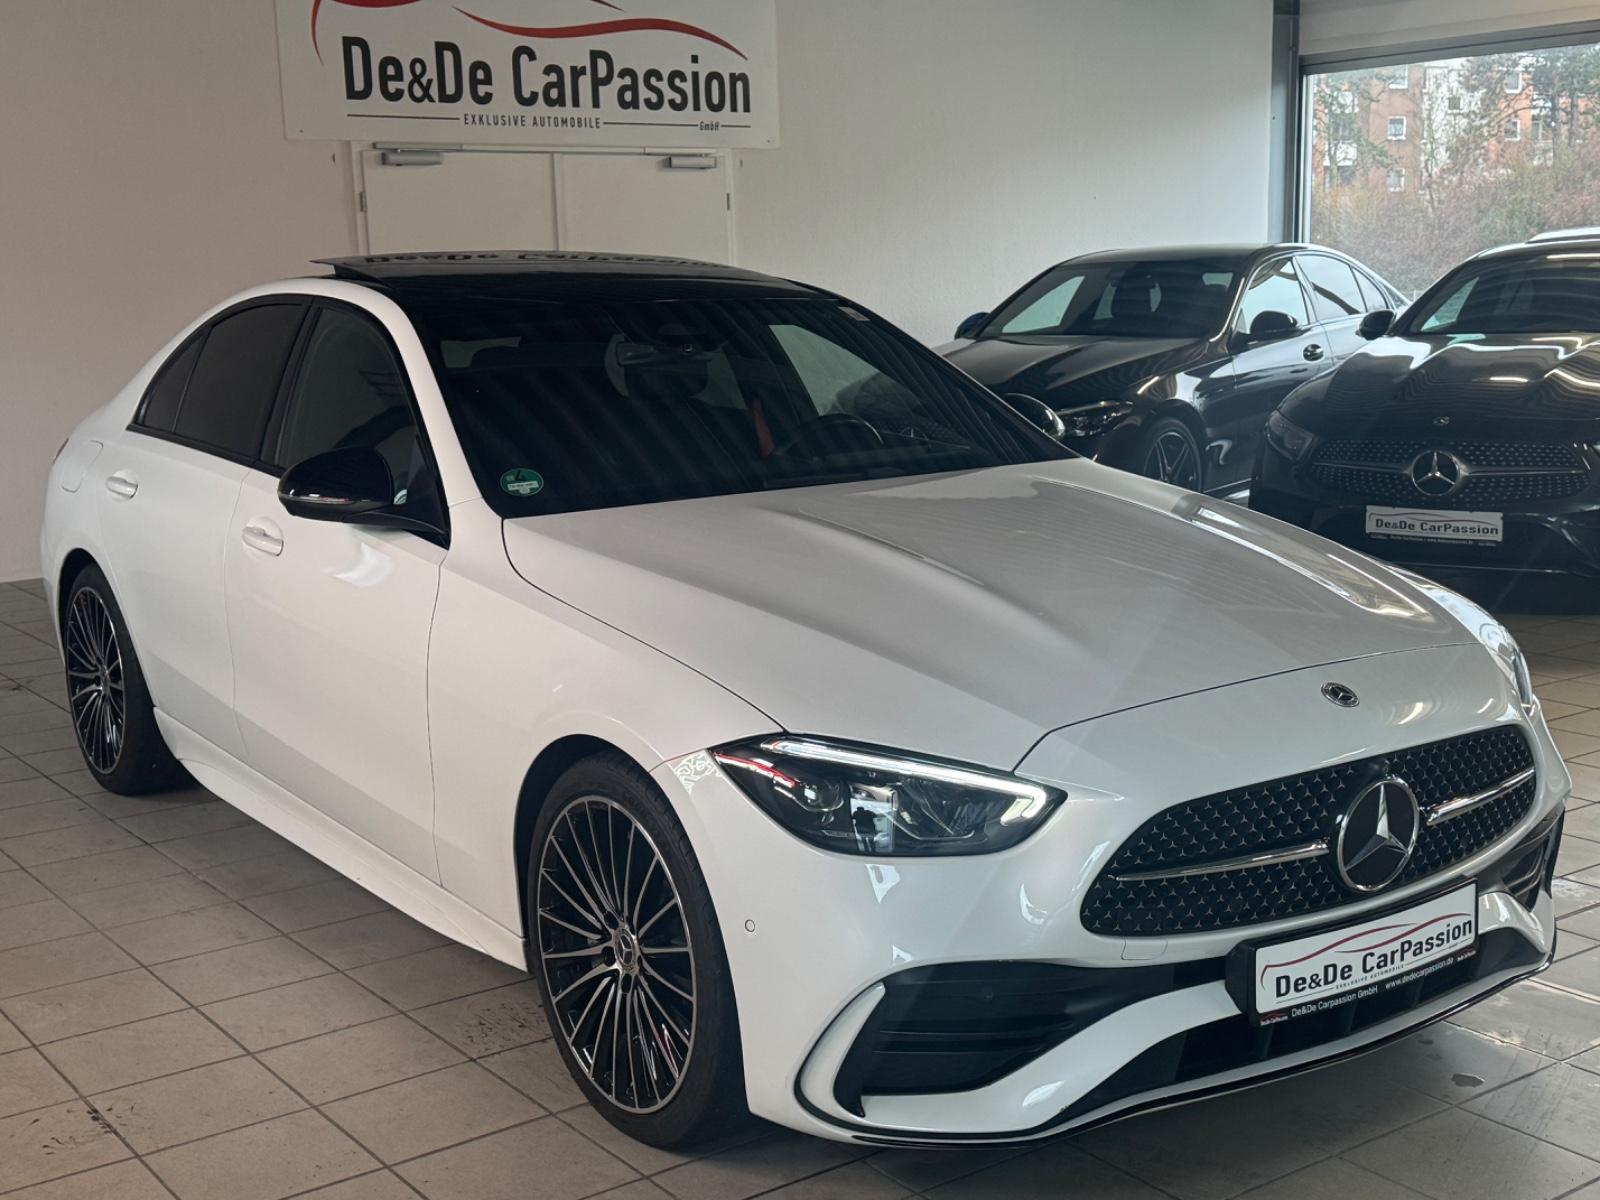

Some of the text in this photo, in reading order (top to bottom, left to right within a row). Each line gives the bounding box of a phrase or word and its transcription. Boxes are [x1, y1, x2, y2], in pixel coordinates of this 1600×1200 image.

[342, 35, 751, 113] De&De CarPassion
[464, 113, 720, 131] EXKLUSIVE AUTOMOBILE GmbH
[1375, 518, 1499, 535] De&De CarPassion
[1275, 919, 1472, 998] De&De CarPassion
[1291, 1004, 1317, 1017] De&De
[1318, 992, 1357, 1009] Carpassion
[1357, 985, 1378, 998] GmbH
